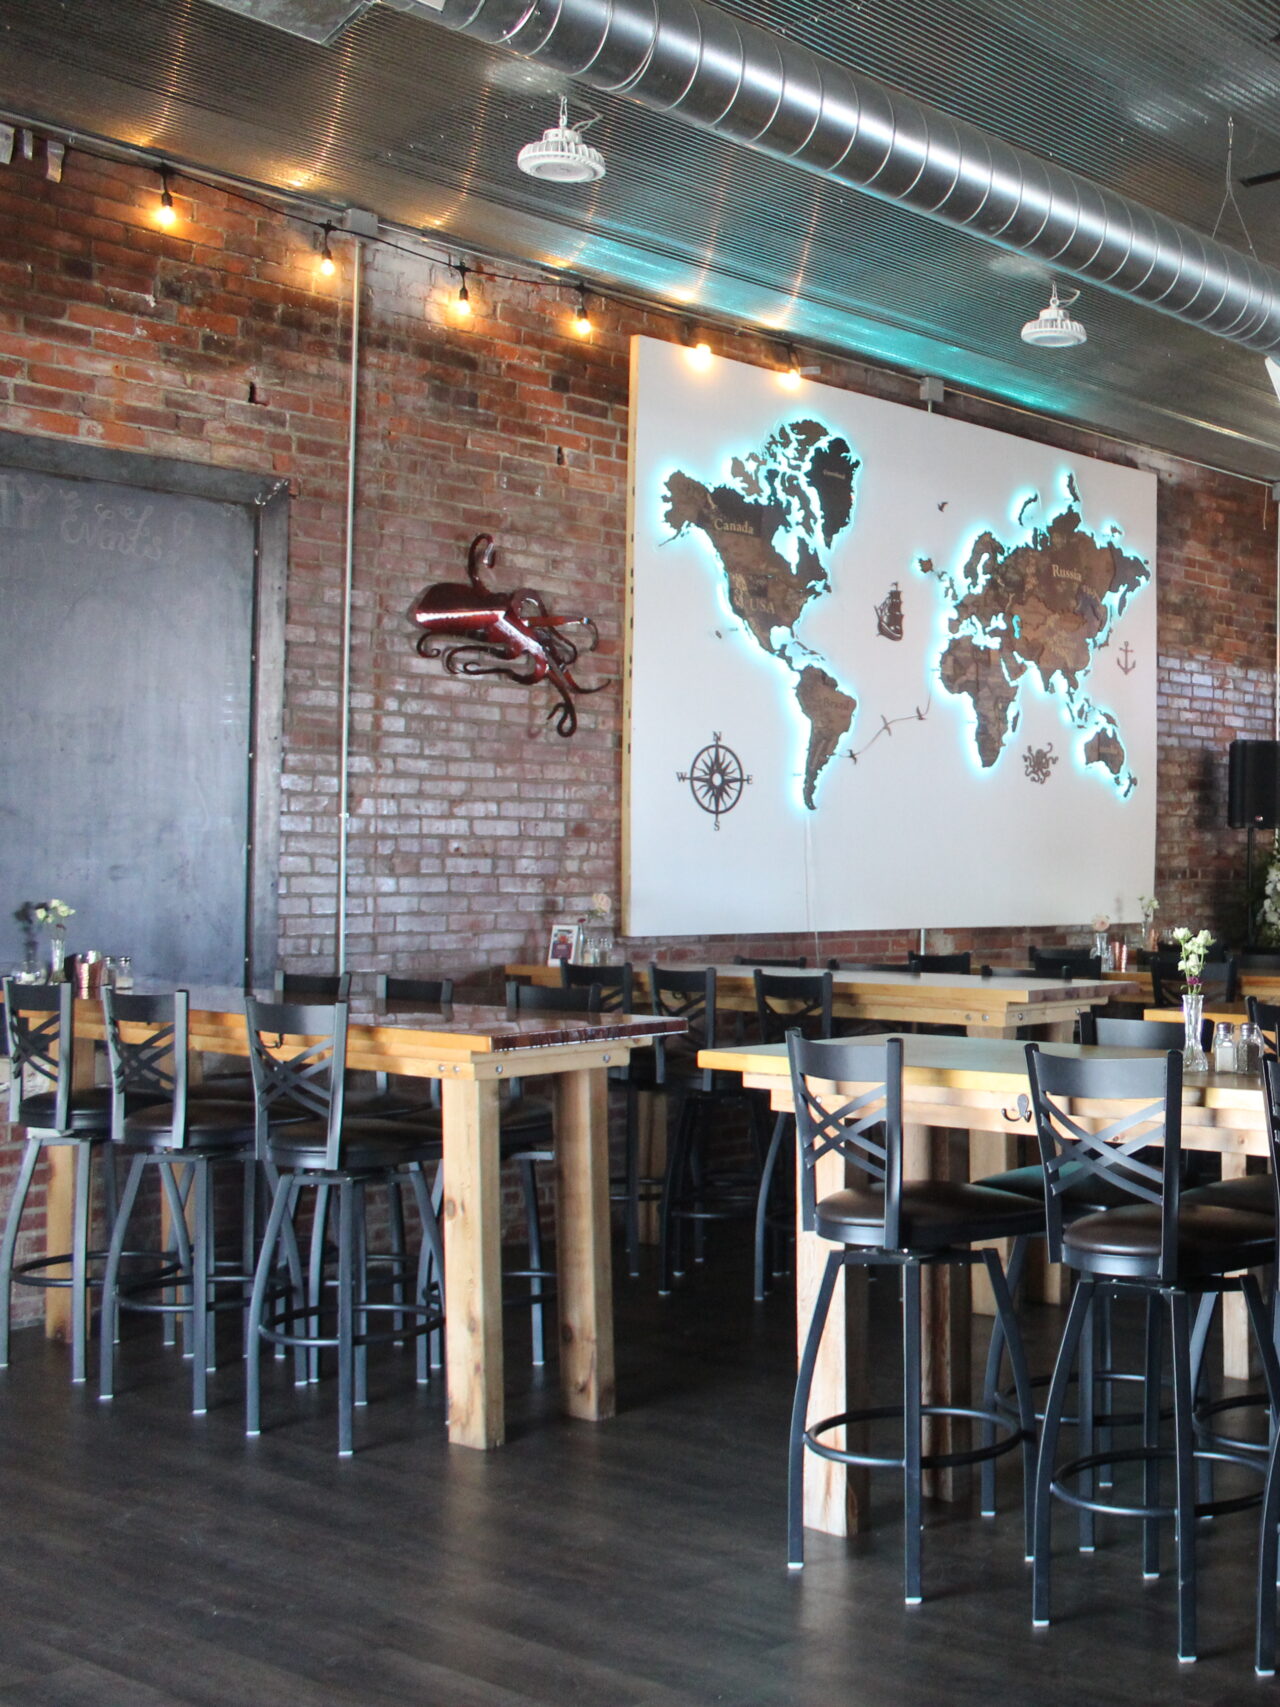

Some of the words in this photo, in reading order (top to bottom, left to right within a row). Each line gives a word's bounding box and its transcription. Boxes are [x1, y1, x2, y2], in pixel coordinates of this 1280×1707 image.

[714, 518, 754, 535] Canada
[1052, 563, 1082, 582] Russia
[748, 598, 776, 614] USA
[712, 731, 722, 742] N
[676, 771, 687, 783] W
[746, 774, 754, 785] E
[713, 820, 721, 832] S
